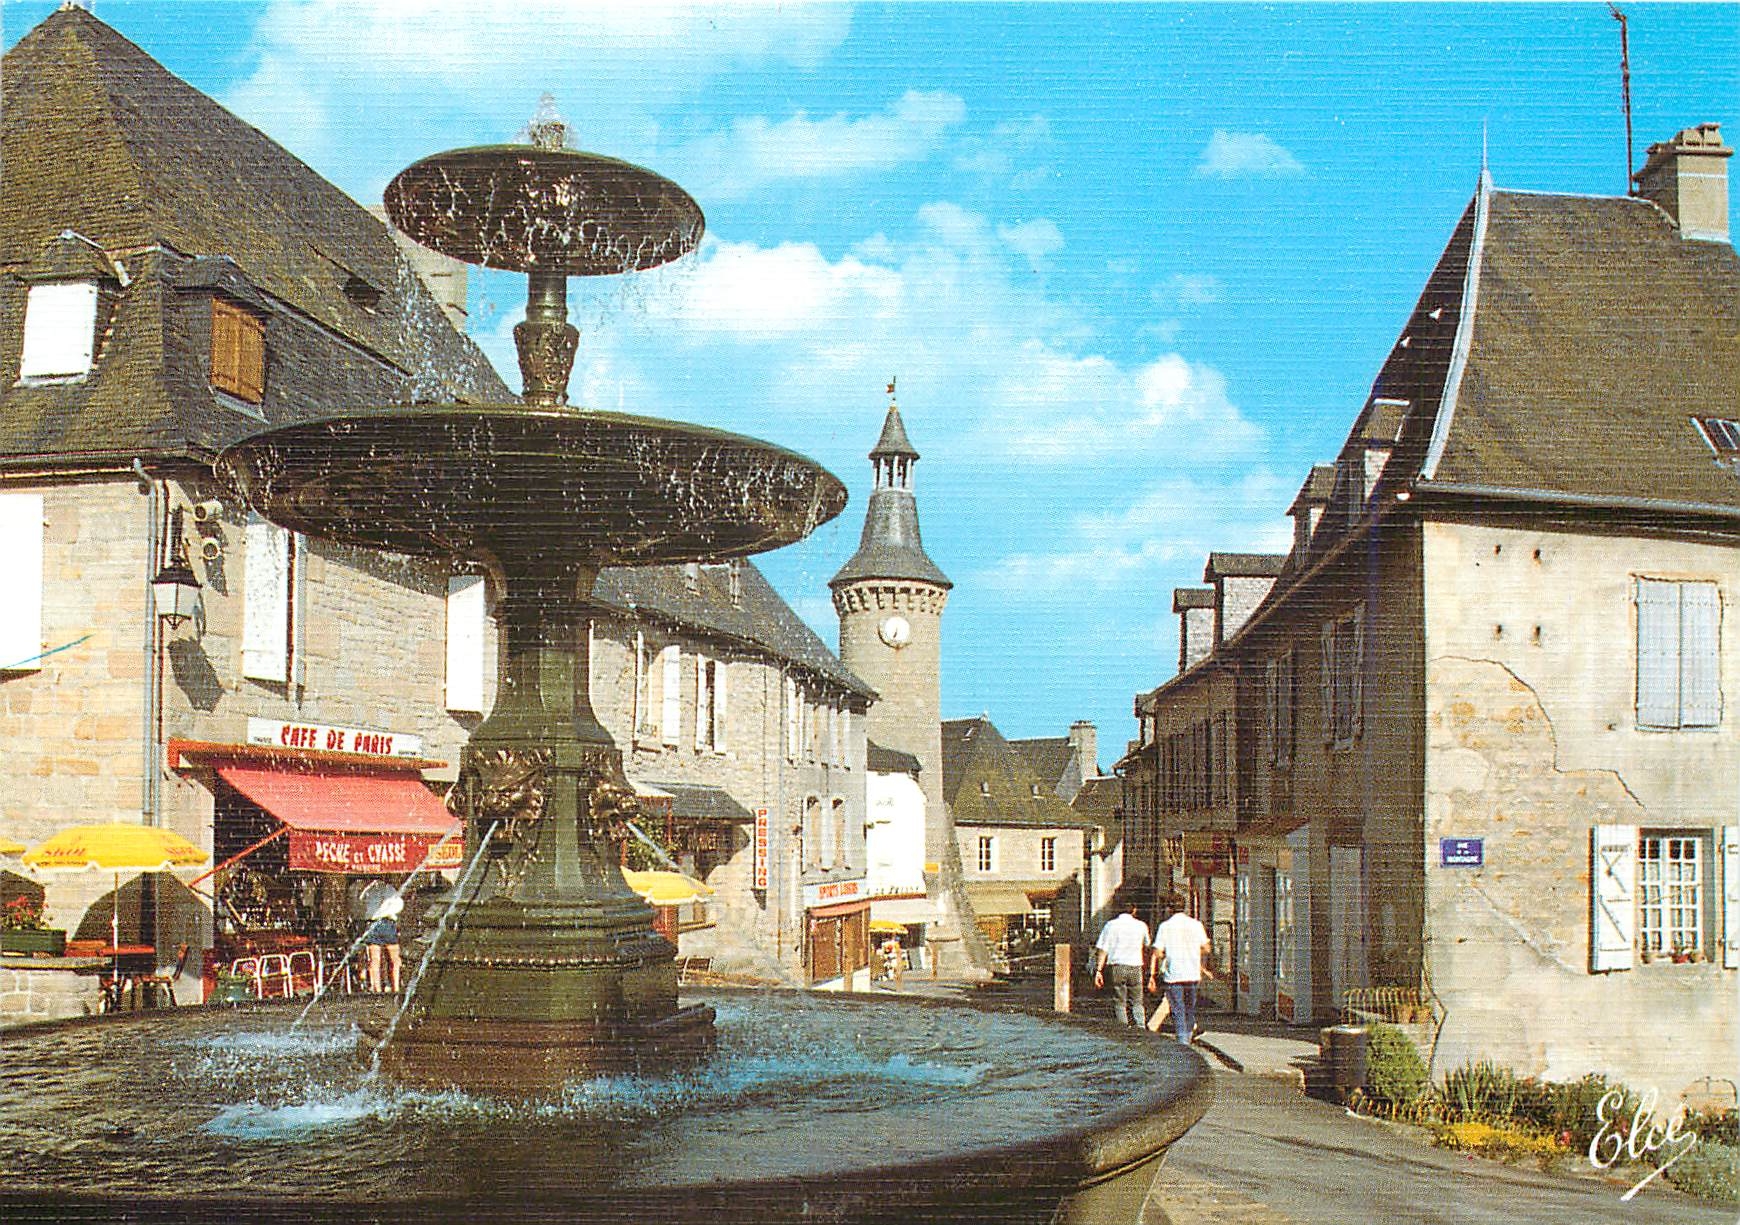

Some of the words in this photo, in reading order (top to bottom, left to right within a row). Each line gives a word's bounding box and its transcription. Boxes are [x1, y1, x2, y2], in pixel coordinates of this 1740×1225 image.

[281, 724, 317, 748] CAFE
[327, 729, 345, 750] DE
[354, 732, 393, 755] PARIS
[758, 809, 767, 886] PRESSING
